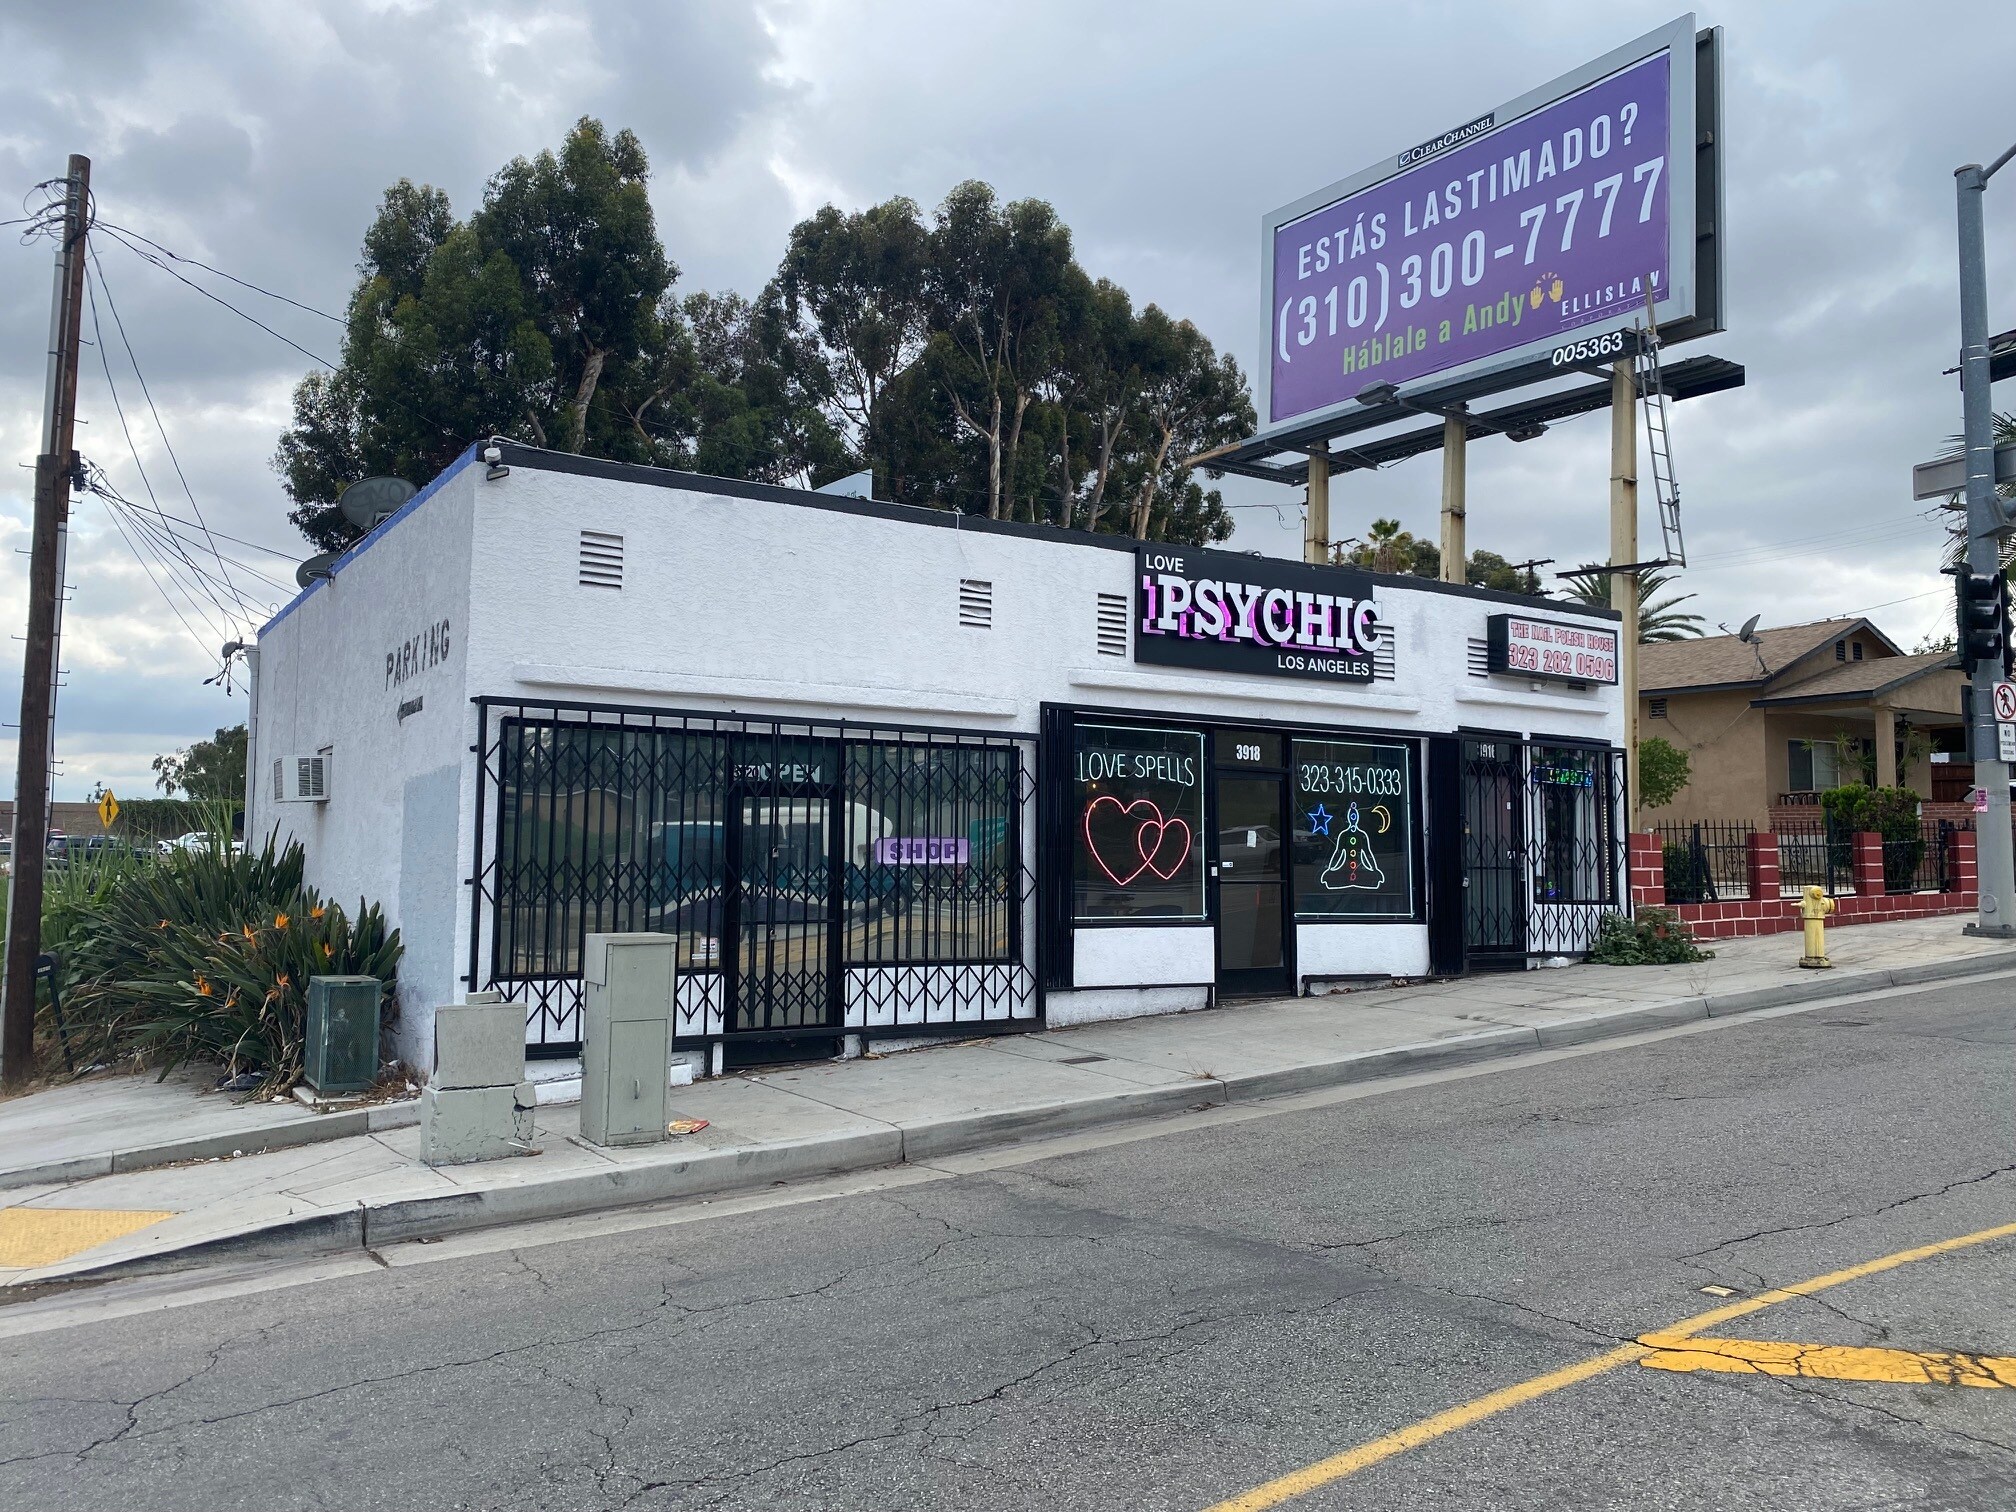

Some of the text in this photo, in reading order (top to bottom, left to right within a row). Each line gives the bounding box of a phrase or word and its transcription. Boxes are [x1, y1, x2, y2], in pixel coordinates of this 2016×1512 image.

[1298, 102, 1638, 281] ESTÁS LASTIMADO?
[1278, 156, 1665, 363] (310)300-7777
[1342, 290, 1525, 376] Háblale a Andy
[1552, 331, 1623, 366] 005363
[1145, 553, 1184, 573] LOVE
[1156, 573, 1384, 652] PSYCHIC
[1510, 621, 1529, 639] THE
[1587, 633, 1614, 653] HOUSE
[385, 618, 450, 692] PARKING
[1277, 654, 1370, 677] LOS ANGELES
[1508, 642, 1614, 680] 323 282 0596
[1078, 751, 1195, 787] LOVE SPELLS
[1236, 744, 1260, 761] 3918
[1301, 763, 1402, 796] 323-315-0333
[889, 842, 959, 860] SHOP
